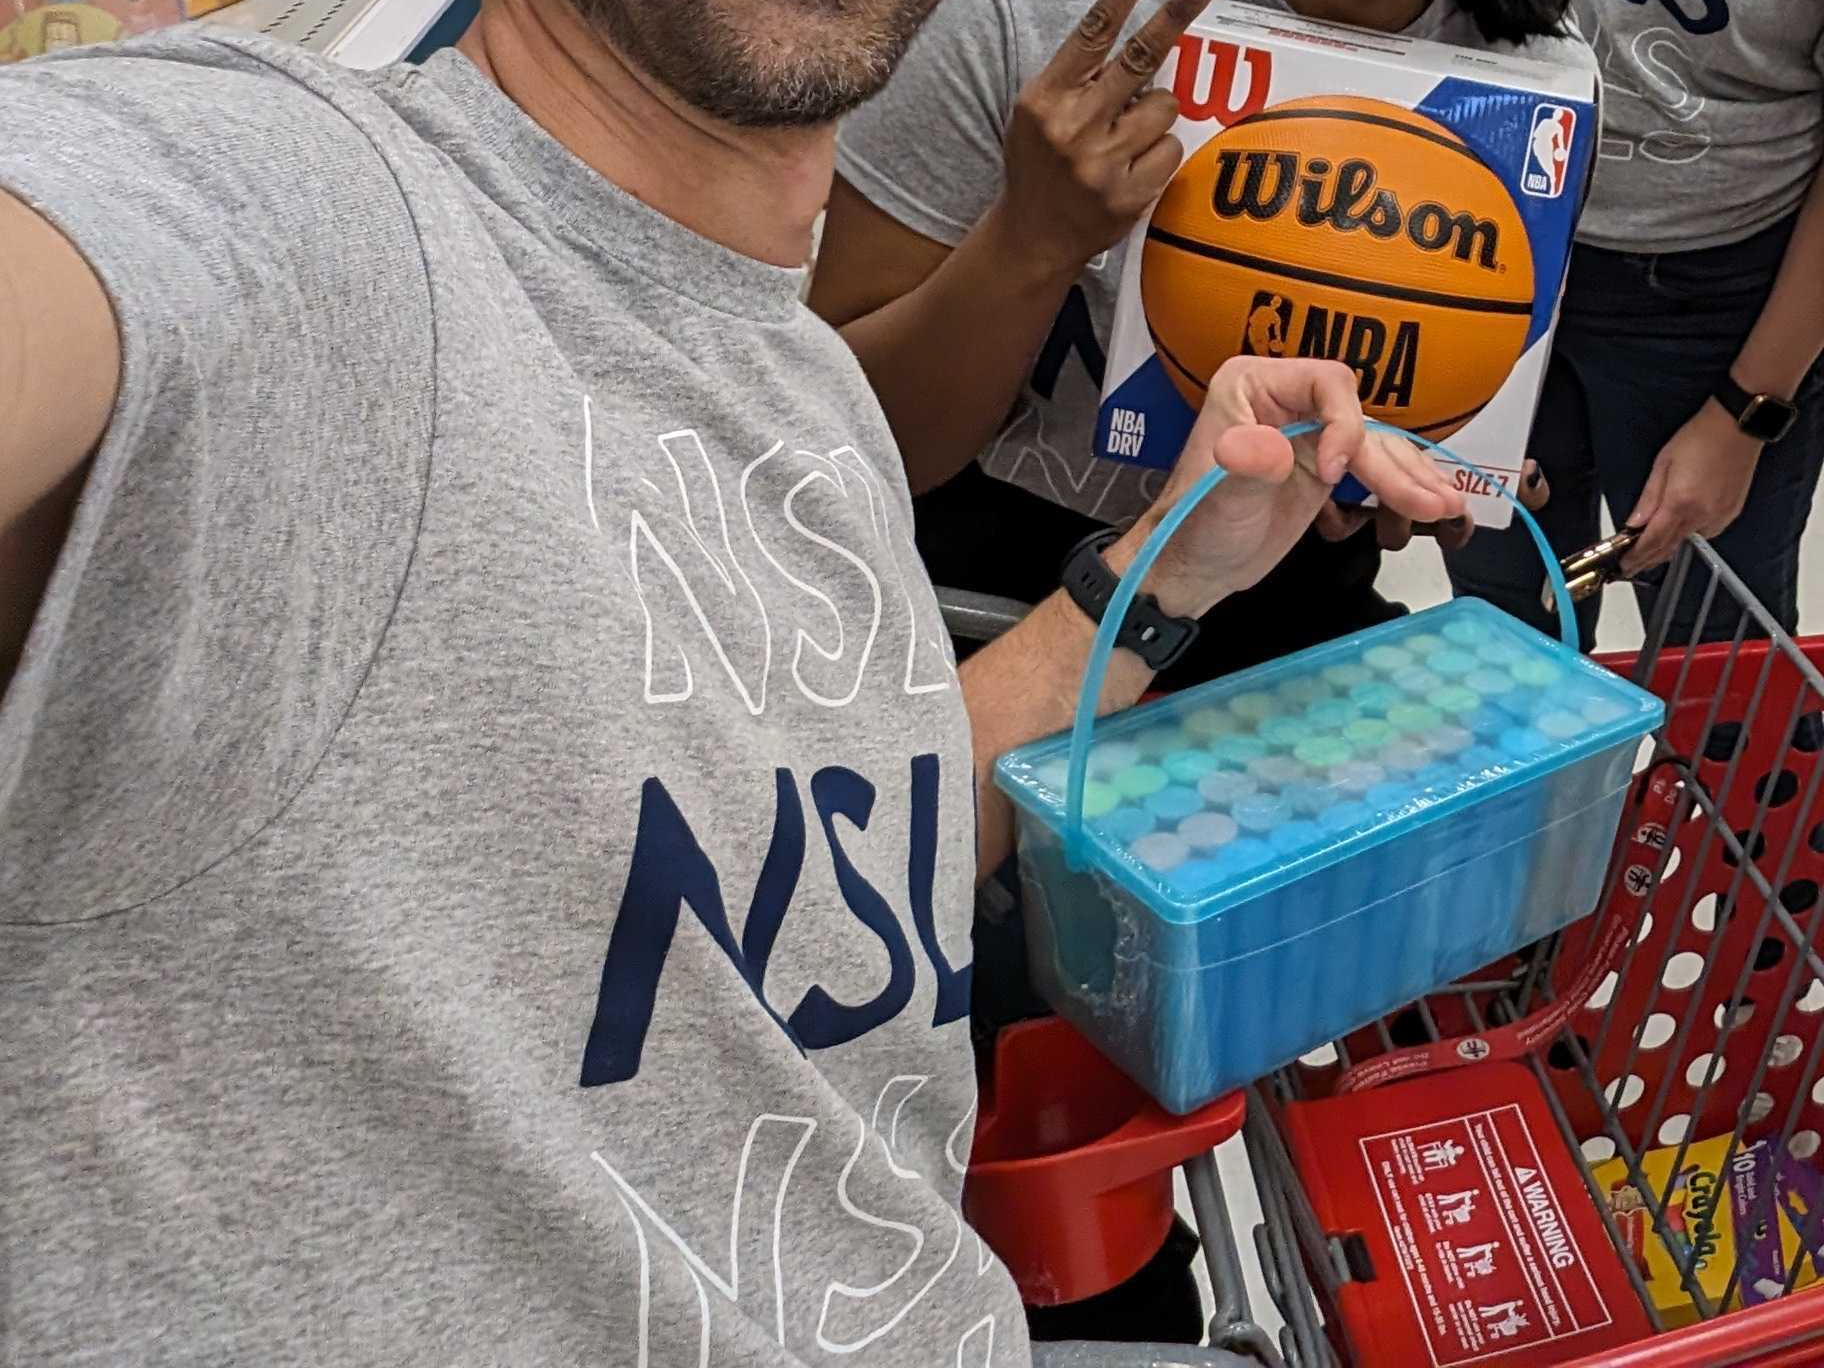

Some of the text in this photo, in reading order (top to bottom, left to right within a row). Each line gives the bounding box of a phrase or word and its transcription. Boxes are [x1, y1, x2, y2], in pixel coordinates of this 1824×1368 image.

[1172, 35, 1273, 126] W
[1211, 148, 1502, 273] Wilson
[1526, 172, 1548, 192] NBA
[1299, 304, 1421, 408] NBA
[1106, 431, 1144, 459] DRV
[1110, 408, 1147, 435] NBA
[1453, 469, 1510, 499] SIZE 7
[584, 395, 957, 715] NSL
[580, 752, 977, 1089] NSL
[1732, 1152, 1757, 1173] 10
[1523, 1181, 1575, 1269] WARNING
